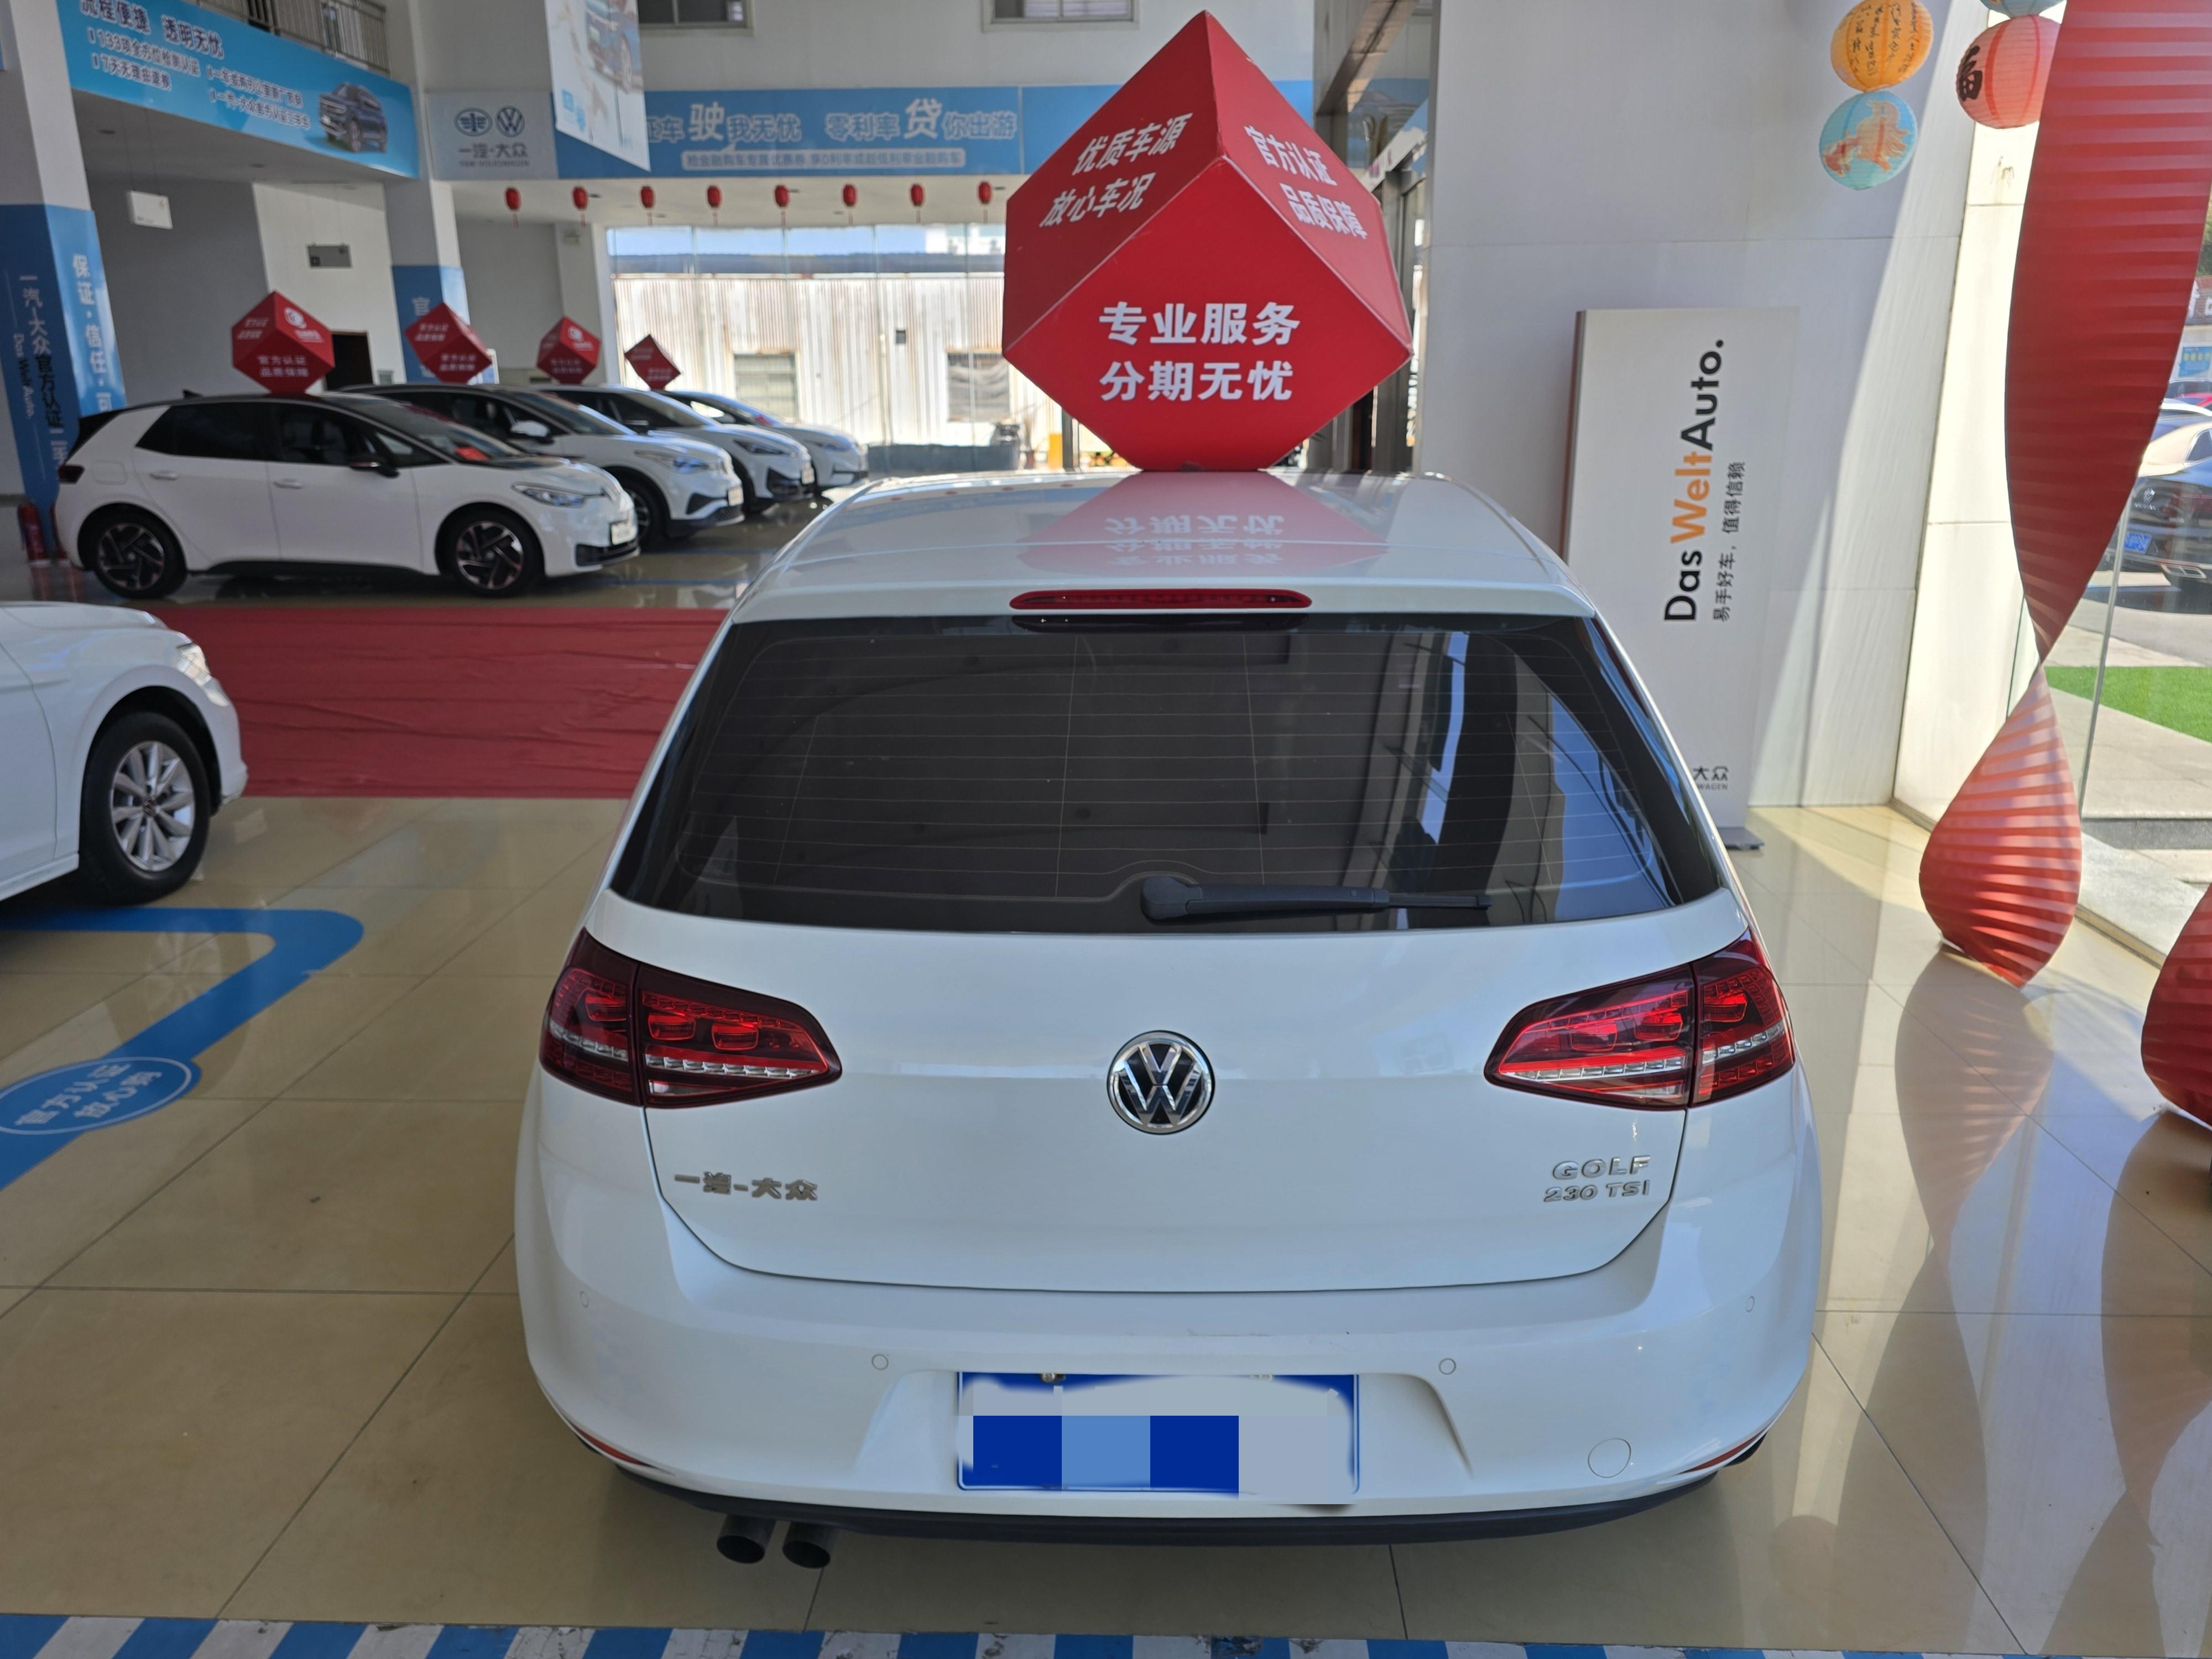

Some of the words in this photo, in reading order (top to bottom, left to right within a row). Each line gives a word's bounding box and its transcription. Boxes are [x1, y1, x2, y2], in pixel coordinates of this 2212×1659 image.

[161, 15, 224, 60] 透明无忧
[825, 98, 1018, 142] 零利率贷你出游
[1071, 112, 1193, 176] 优质车源
[1244, 125, 1338, 187] 官方认证
[1039, 172, 1156, 228] 放心车况
[1279, 182, 1369, 240] 品质保障
[1099, 301, 1301, 345] 专业服务
[1099, 361, 1293, 401] 分期无忧
[1664, 550, 1704, 623] Das
[13, 1063, 132, 1125] 官方认证
[1543, 1185, 1598, 1202] 230
[1606, 1180, 1651, 1198] TSI
[1553, 1155, 1651, 1180] GOLF
